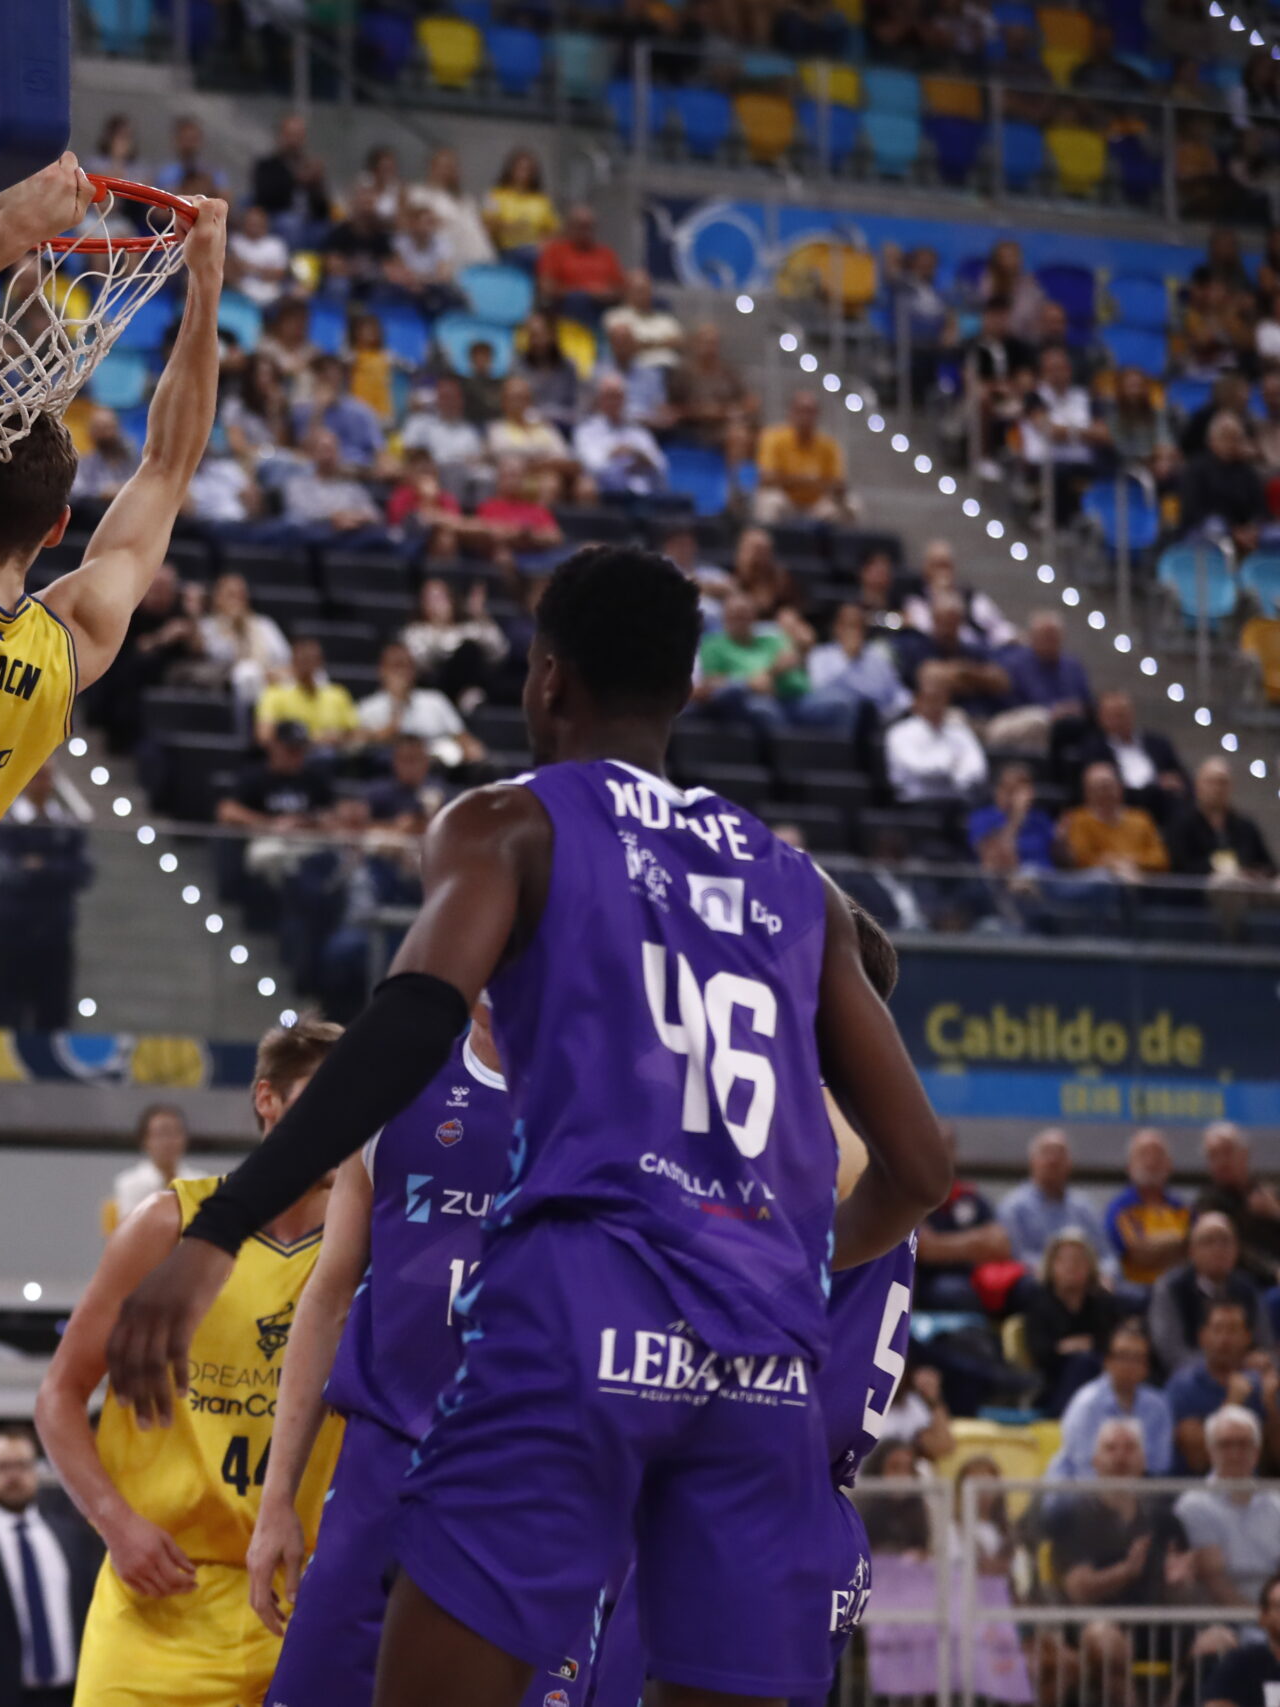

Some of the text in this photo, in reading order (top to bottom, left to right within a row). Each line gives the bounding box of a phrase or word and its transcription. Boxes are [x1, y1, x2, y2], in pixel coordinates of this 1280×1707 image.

[605, 779, 754, 861] NDYE
[641, 940, 778, 1159] 46
[925, 1003, 1204, 1067] Cabildo de
[736, 1180, 755, 1205] Y
[447, 1258, 482, 1327] 1
[861, 1280, 911, 1440] 5
